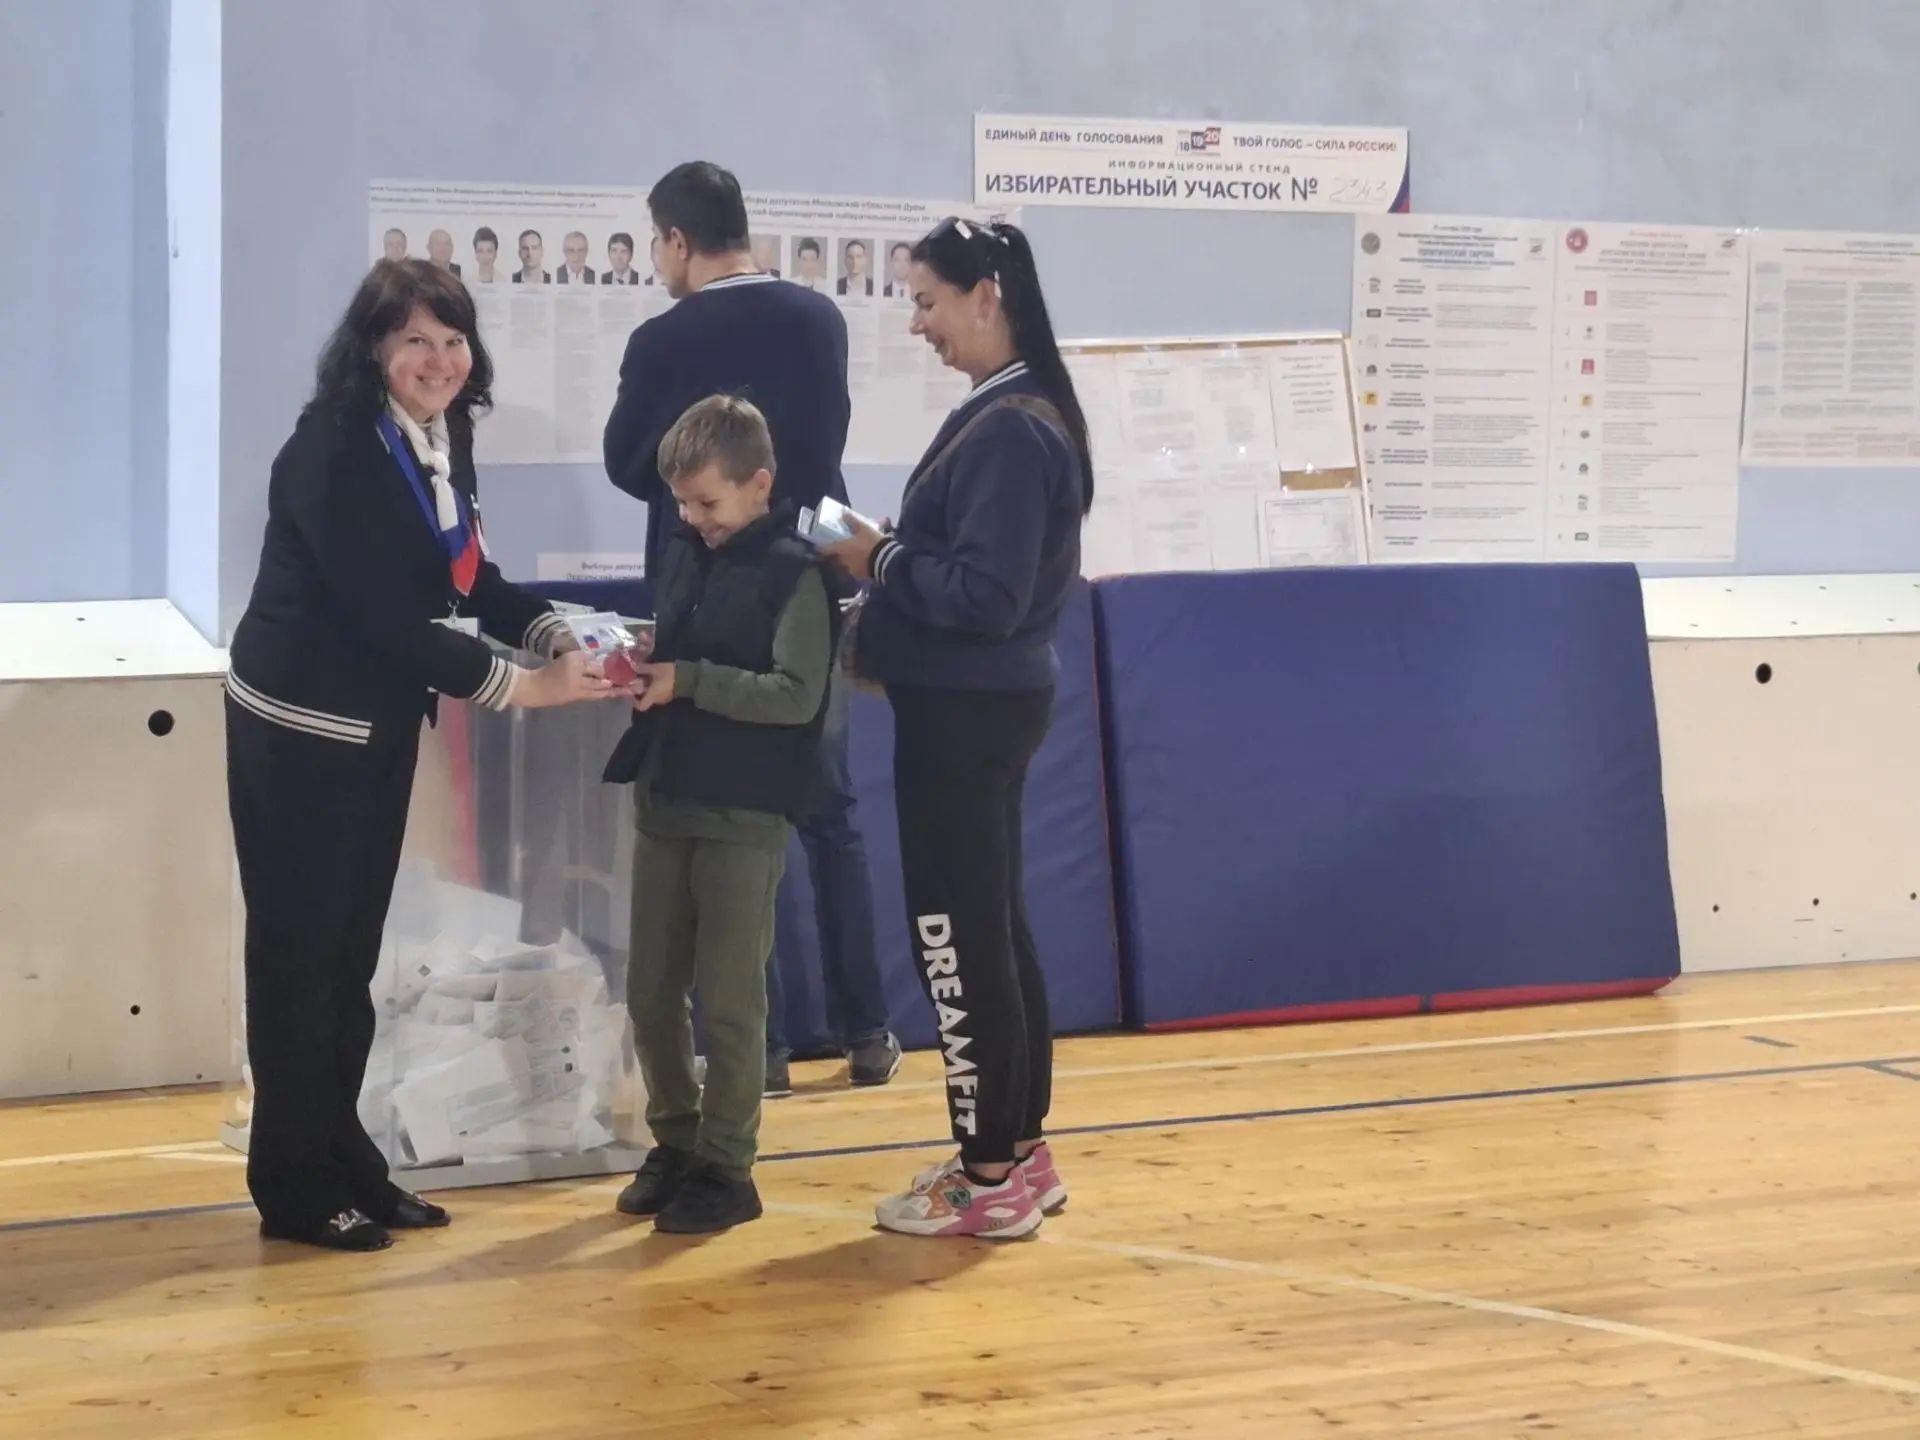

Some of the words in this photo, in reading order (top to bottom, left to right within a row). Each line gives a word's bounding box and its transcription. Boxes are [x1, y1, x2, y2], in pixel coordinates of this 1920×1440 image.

[985, 128, 1037, 141] ЕДИНЫЙ
[1039, 131, 1071, 143] ДЕНЬ
[1077, 131, 1164, 145] ГОЛОСОВАНИЯ
[1232, 135, 1263, 149] ТВОЙ
[1265, 137, 1304, 149] ГОЛОС
[1315, 140, 1346, 151] СИЛА
[1348, 140, 1397, 153] РОССИИ!
[1108, 160, 1244, 173] ИНФОРМАЦИОННЫЙ
[1249, 163, 1291, 176] СТЕНД
[985, 174, 1178, 197] ИЗБИРАТЕЛЬНЫЙ
[1184, 179, 1282, 200] УЧАСТОК
[615, 563, 645, 571] депута
[917, 914, 979, 1136] DREAMFIT
